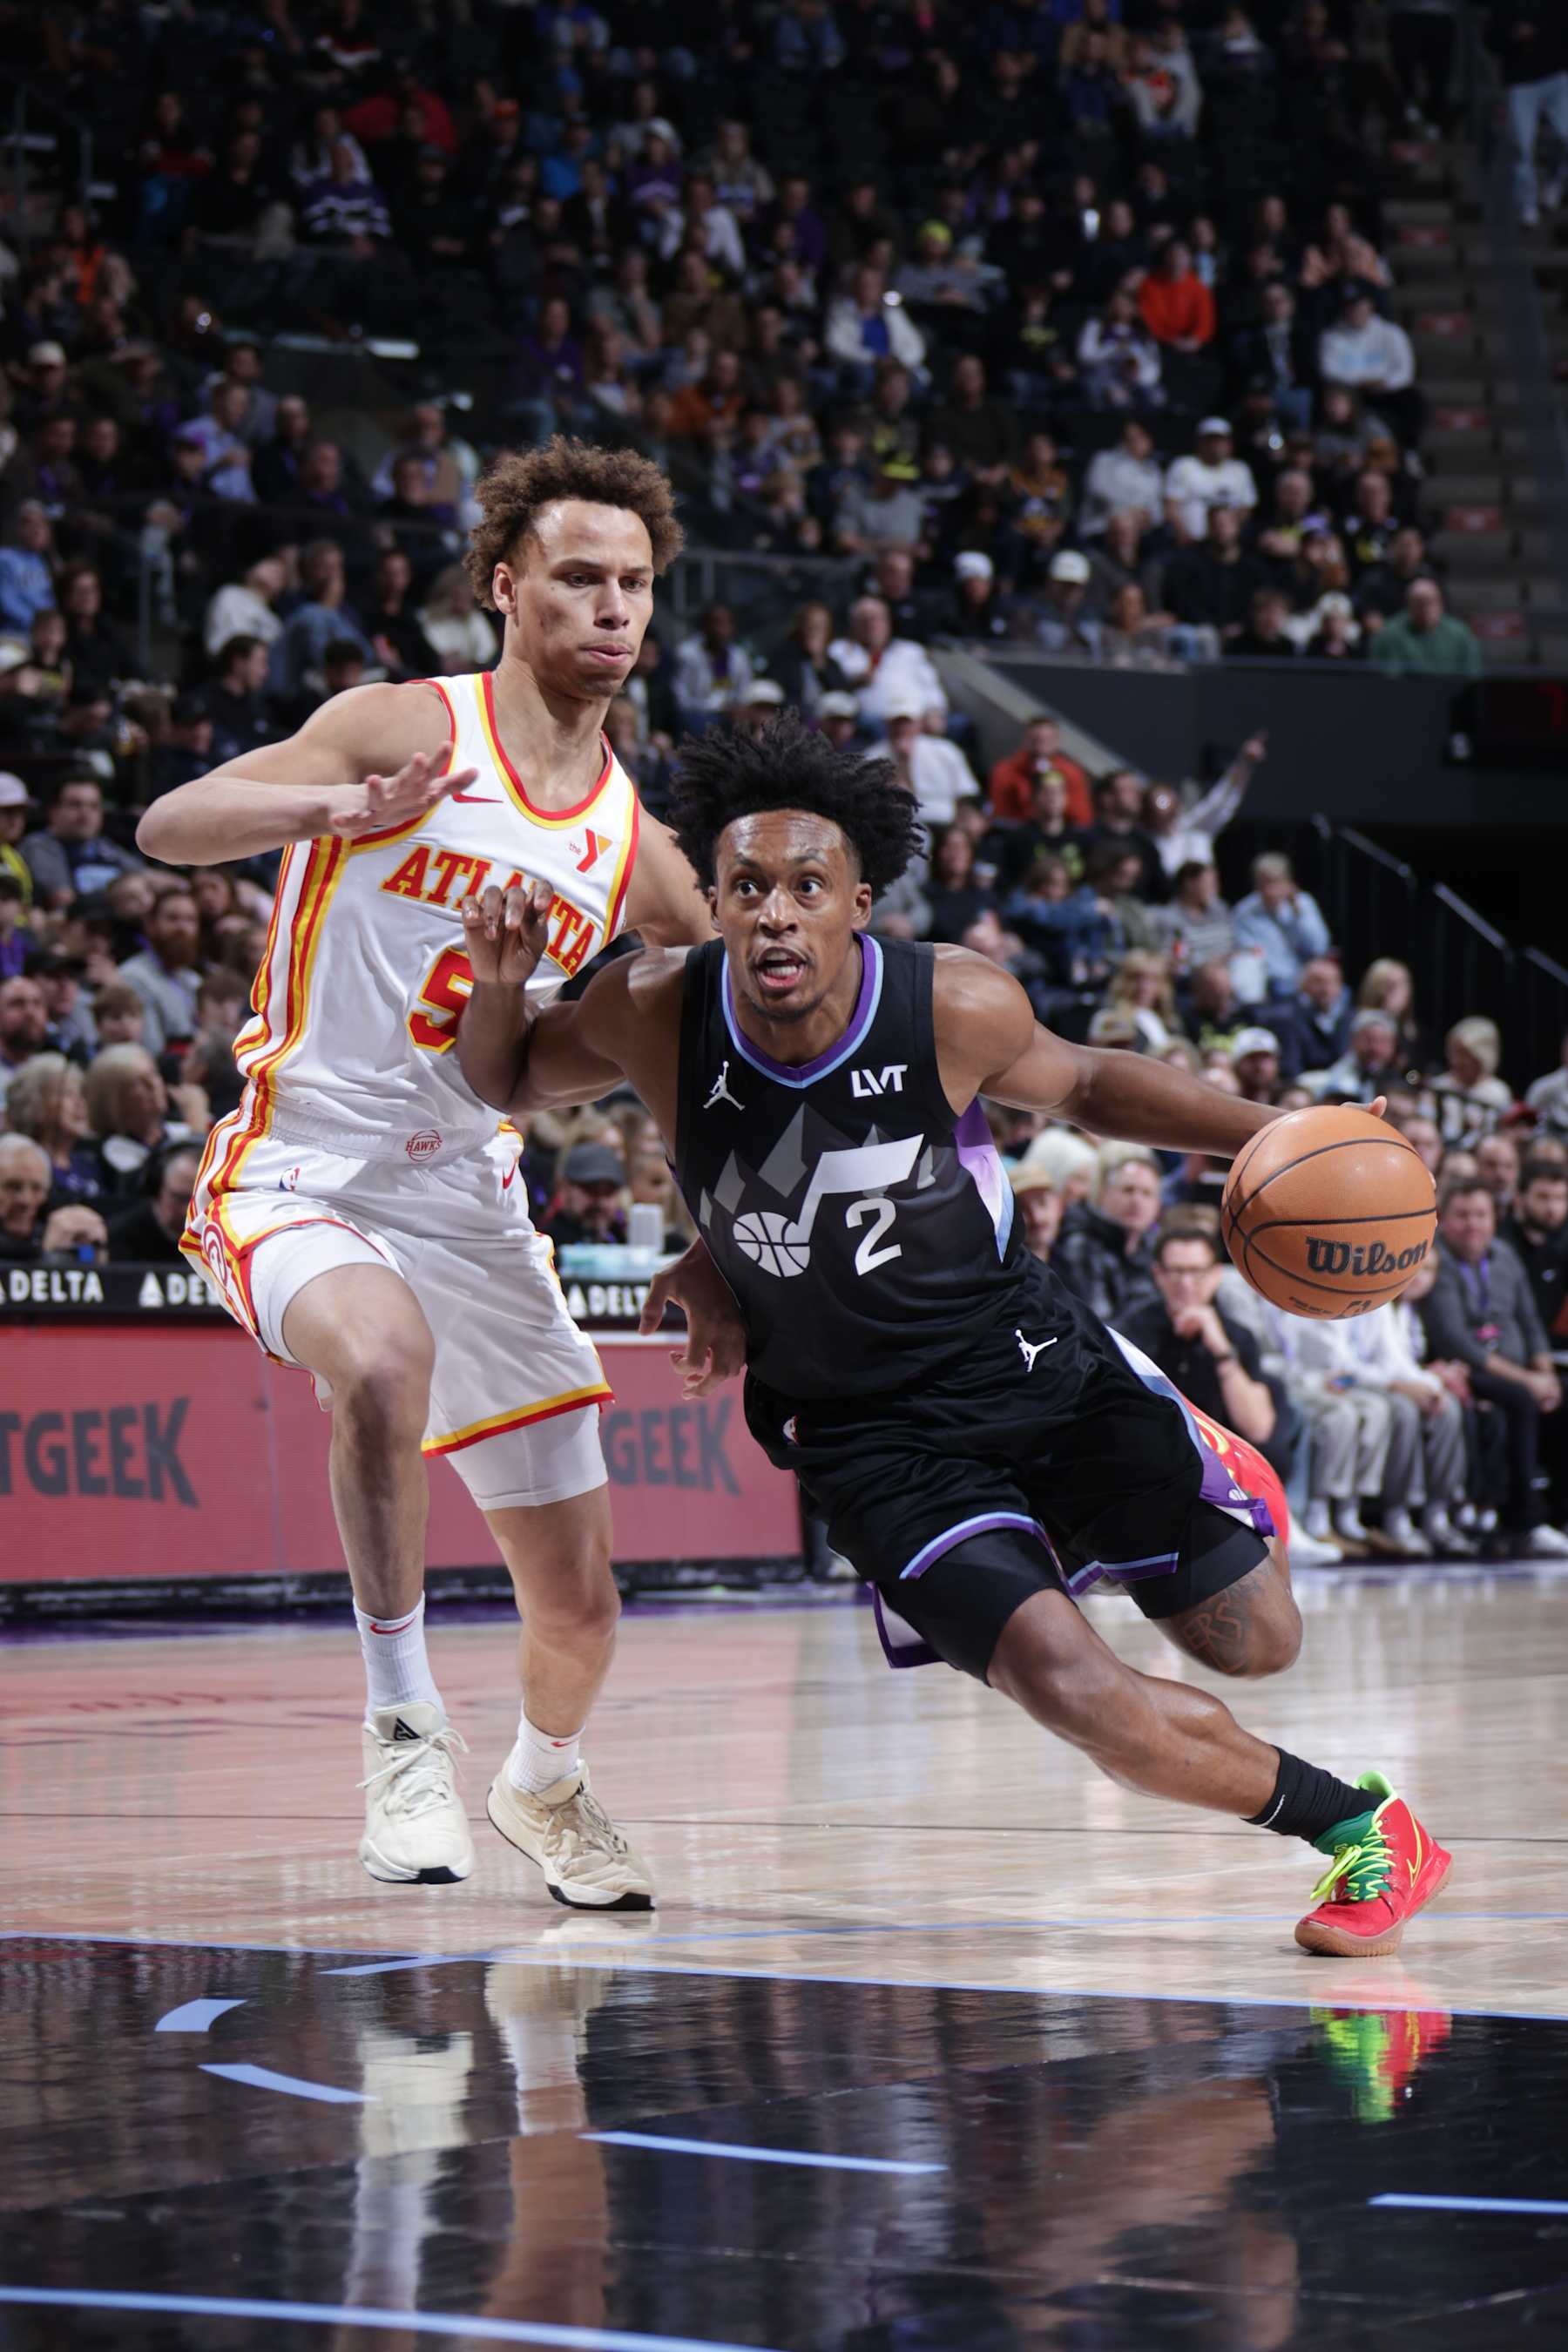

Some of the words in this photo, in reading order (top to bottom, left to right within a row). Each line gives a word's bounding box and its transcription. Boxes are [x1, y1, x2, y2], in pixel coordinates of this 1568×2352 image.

[379, 845, 598, 979] ATLTA
[407, 946, 475, 1054] 5
[851, 1064, 908, 1098] LVT
[405, 1139, 443, 1152] HAWKS
[845, 1198, 902, 1276] 2
[1306, 1236, 1428, 1276] Wilson
[9, 1268, 104, 1302] DELTA
[588, 1284, 651, 1316] DELT
